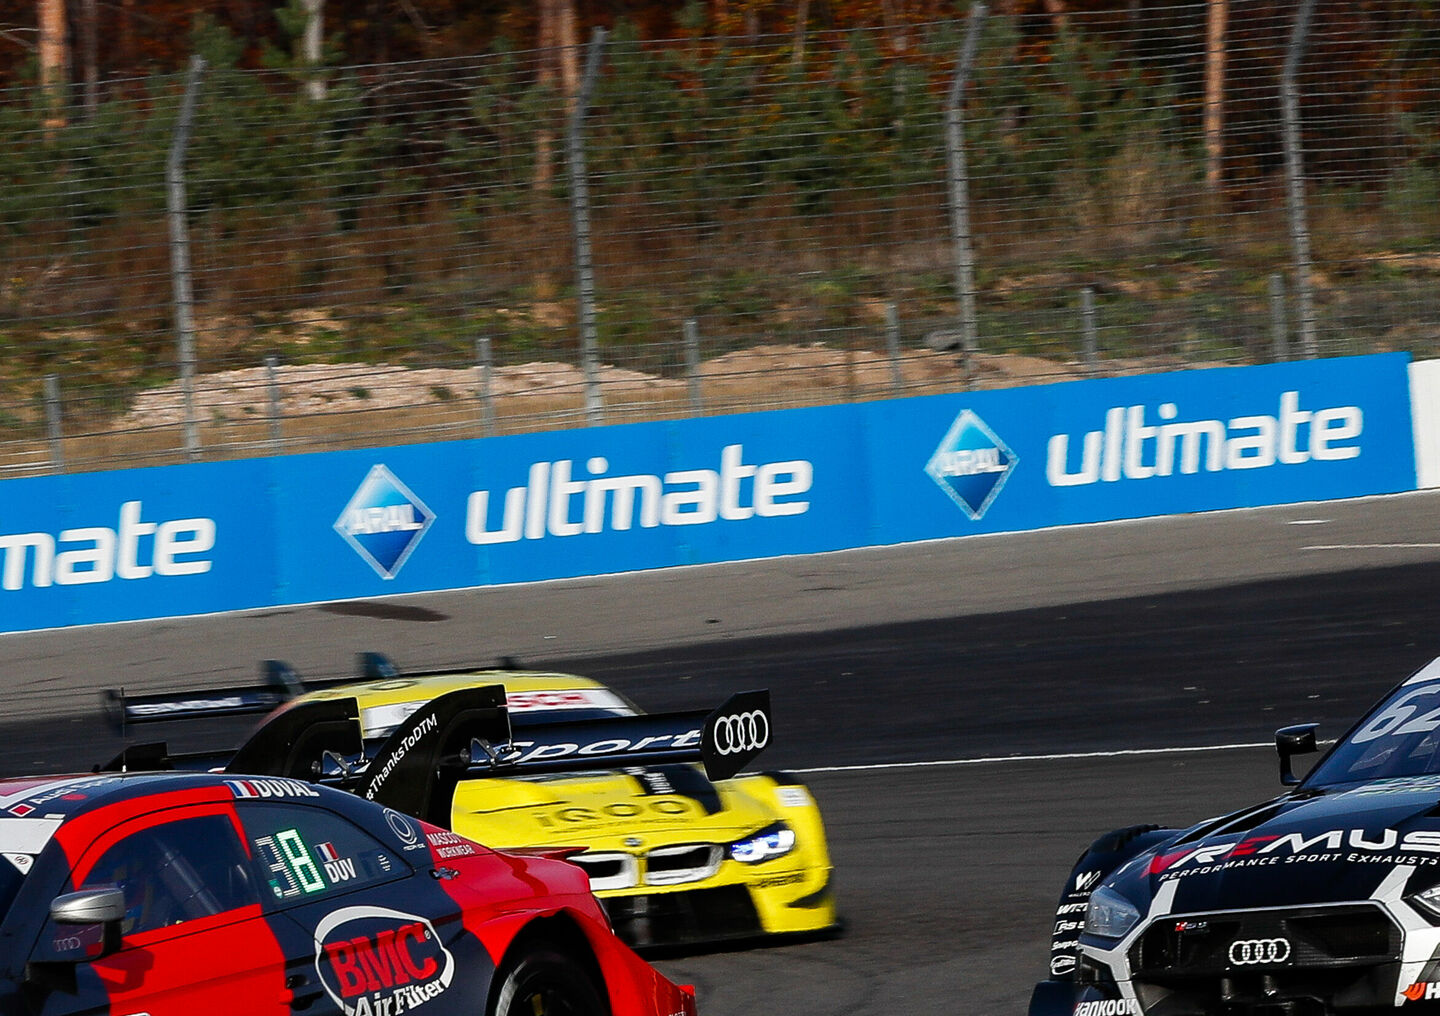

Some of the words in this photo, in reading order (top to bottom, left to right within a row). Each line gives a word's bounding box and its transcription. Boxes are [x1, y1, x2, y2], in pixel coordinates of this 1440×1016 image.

[1047, 391, 1362, 486] ultimate
[940, 447, 1009, 477] ARAL
[466, 444, 813, 545] ultimate
[348, 504, 423, 534] ARAL
[366, 713, 437, 800] #ThanksToDTM
[255, 779, 320, 797] DUVAL
[324, 858, 357, 884] DUV
[1159, 856, 1278, 882] PERFORMANCE
[1285, 852, 1342, 864] SPORT
[1347, 852, 1439, 866] EXHAUSTS
[324, 922, 438, 998] BMC
